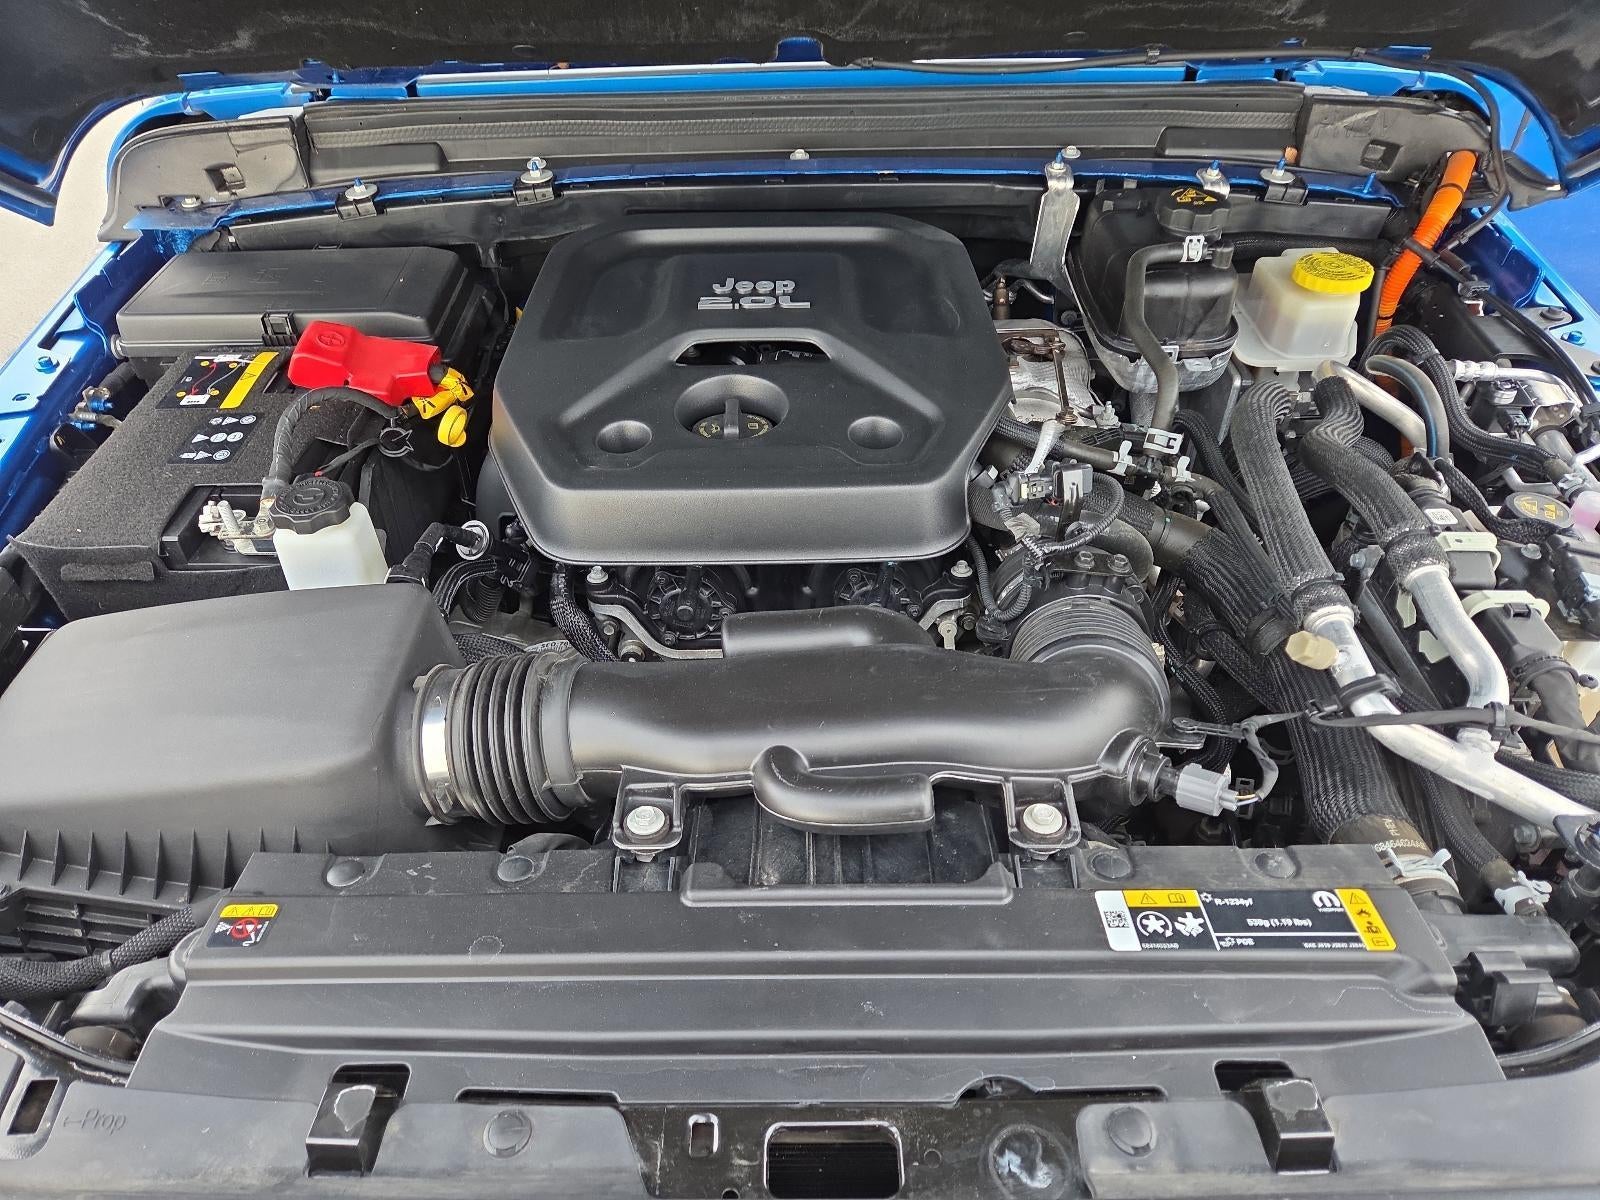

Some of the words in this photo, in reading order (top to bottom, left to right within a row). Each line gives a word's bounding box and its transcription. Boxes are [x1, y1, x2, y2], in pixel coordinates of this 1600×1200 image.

[712, 277, 796, 295] Jeep
[698, 295, 811, 310] 2.0L
[80, 1108, 127, 1137] Prop
